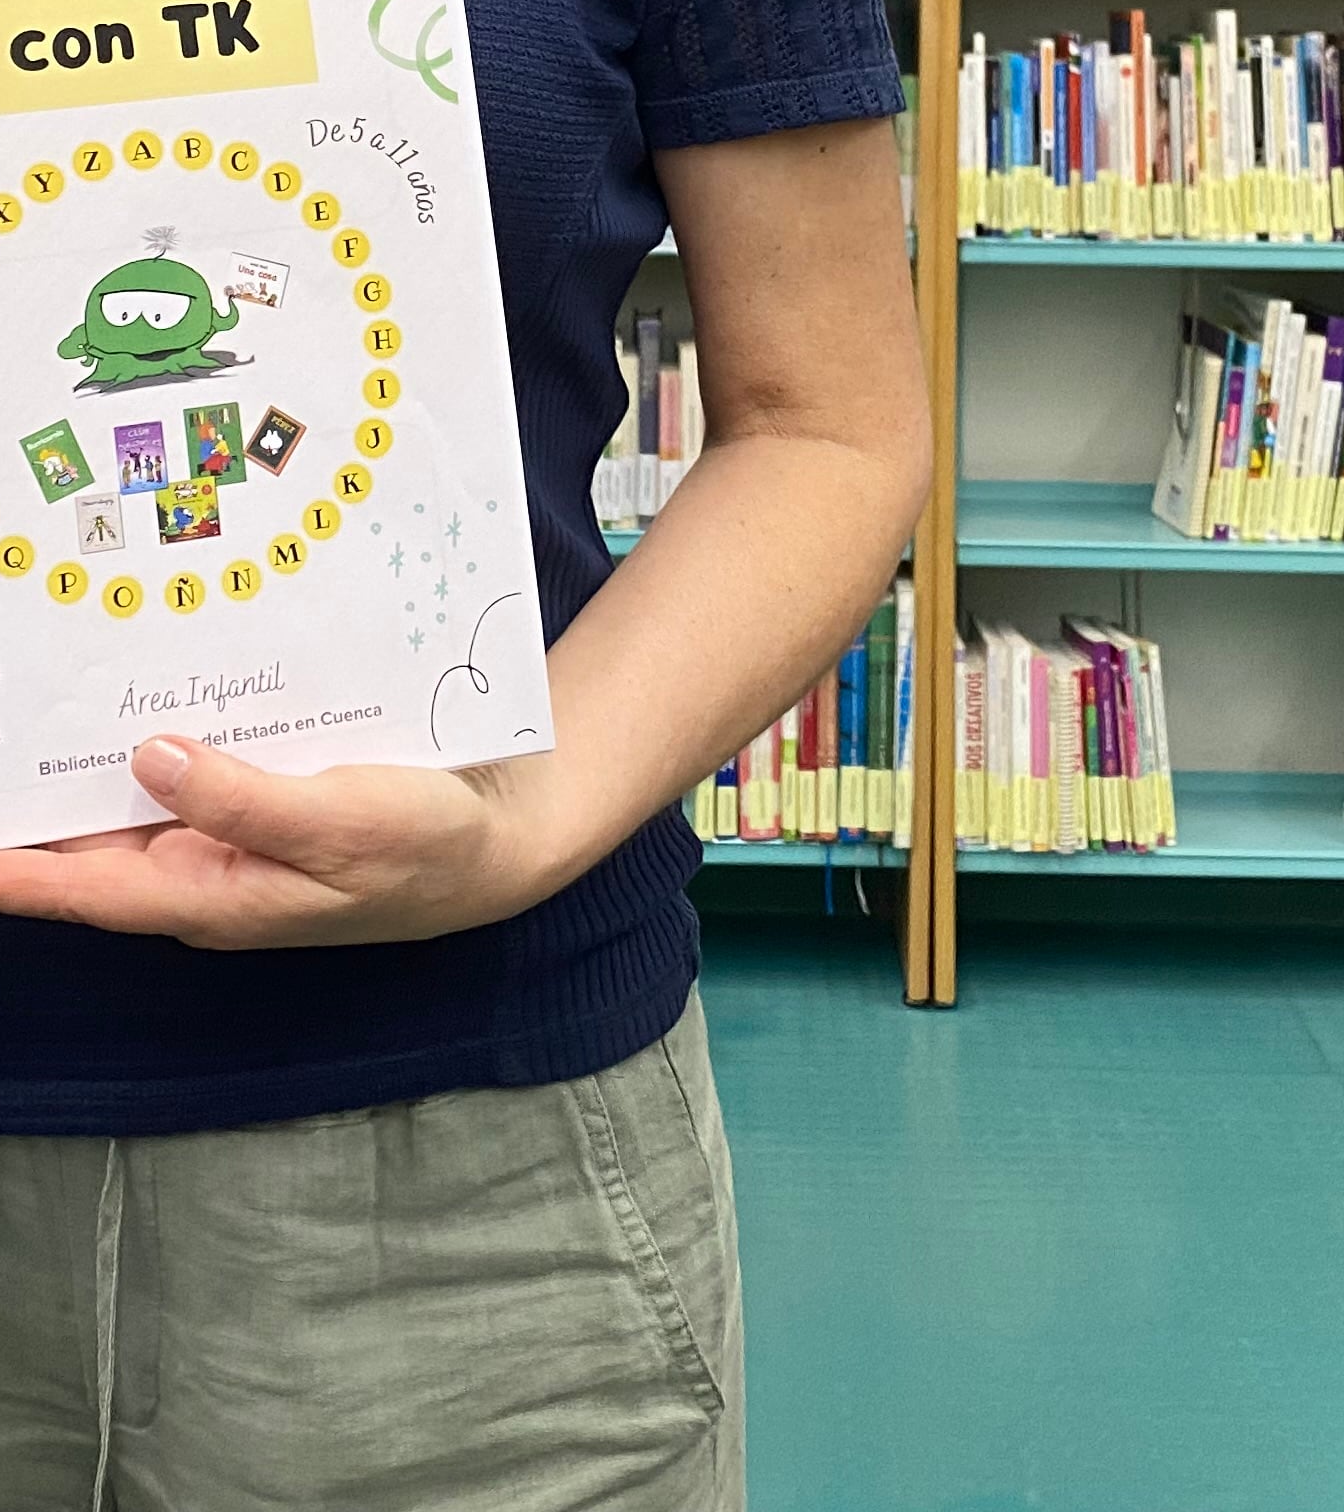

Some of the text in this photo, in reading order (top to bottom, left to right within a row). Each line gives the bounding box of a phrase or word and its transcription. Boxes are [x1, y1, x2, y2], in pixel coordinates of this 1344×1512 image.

[10, 0, 259, 71] con TK
[132, 140, 155, 161] A
[183, 137, 201, 159] B
[83, 150, 101, 172] Z
[231, 150, 249, 172] C
[306, 119, 346, 147] De
[349, 116, 367, 143] 5
[369, 133, 387, 150] a
[407, 169, 436, 225] años
[31, 171, 53, 194] Y
[272, 171, 291, 192] D
[314, 200, 330, 222] E
[343, 237, 358, 259] F
[258, 271, 277, 281] cosa
[363, 280, 382, 302] G
[371, 328, 393, 351] H
[376, 378, 387, 400] I
[366, 427, 380, 449] J
[341, 472, 363, 495] K
[312, 508, 330, 530] L
[3, 546, 26, 570] Q
[273, 542, 301, 566] M
[59, 572, 77, 594] P
[230, 567, 251, 592] N
[113, 586, 134, 608] O
[175, 577, 195, 608] Ñ
[118, 660, 286, 719] Área Infantil
[39, 703, 383, 777] Biblioteca del Estado en Cuenca
